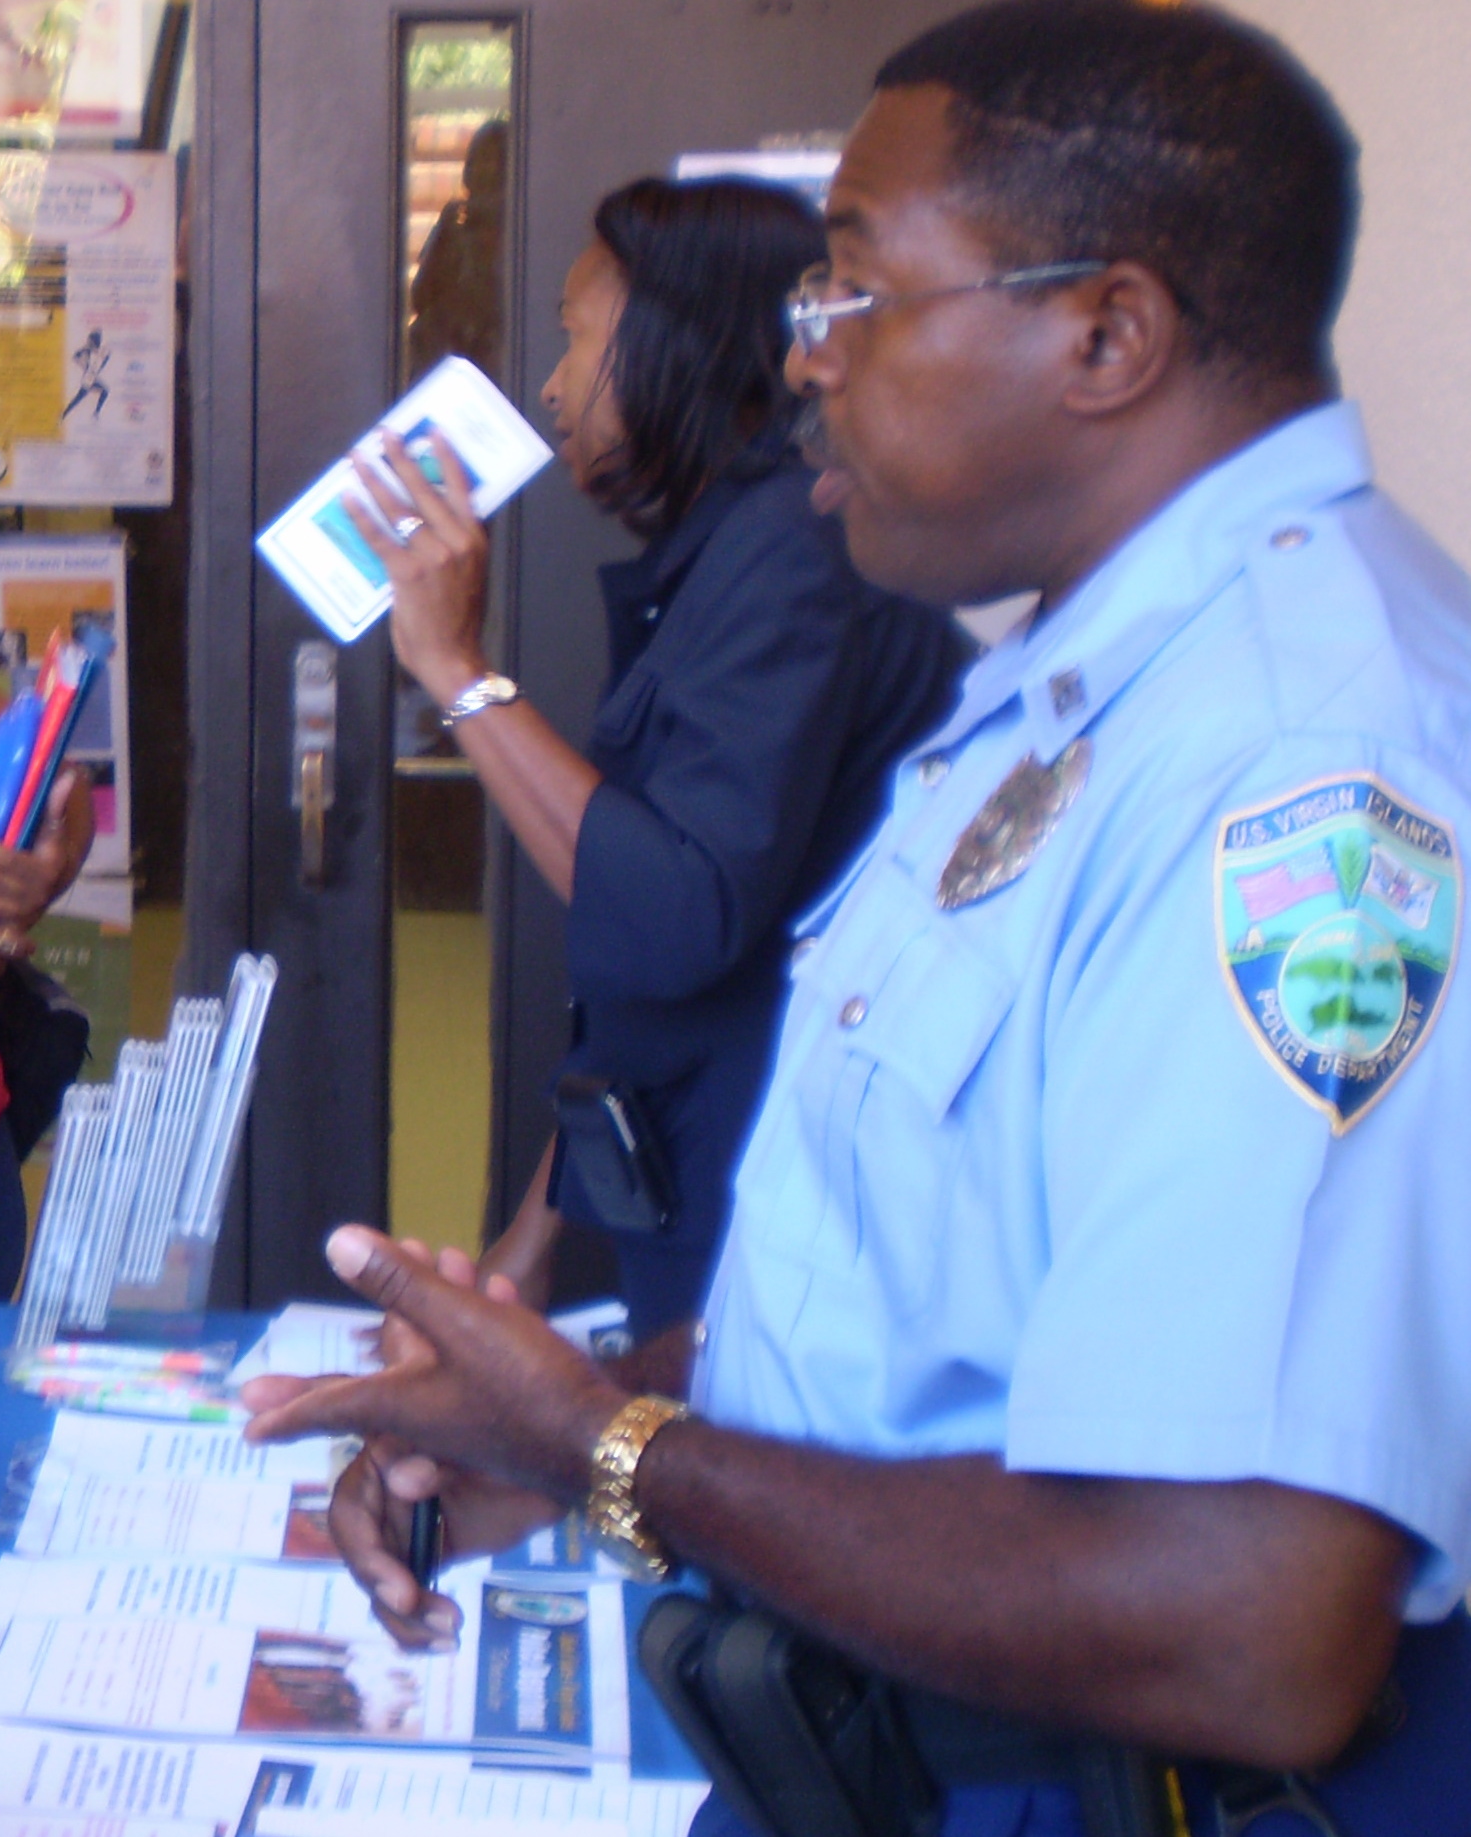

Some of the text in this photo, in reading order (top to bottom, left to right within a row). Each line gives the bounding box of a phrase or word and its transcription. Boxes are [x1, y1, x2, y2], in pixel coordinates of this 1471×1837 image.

[1272, 784, 1357, 836] VIRGIN
[1364, 787, 1452, 859] ISLANDS
[1255, 987, 1426, 1082] POLICE DEPARTMENT
